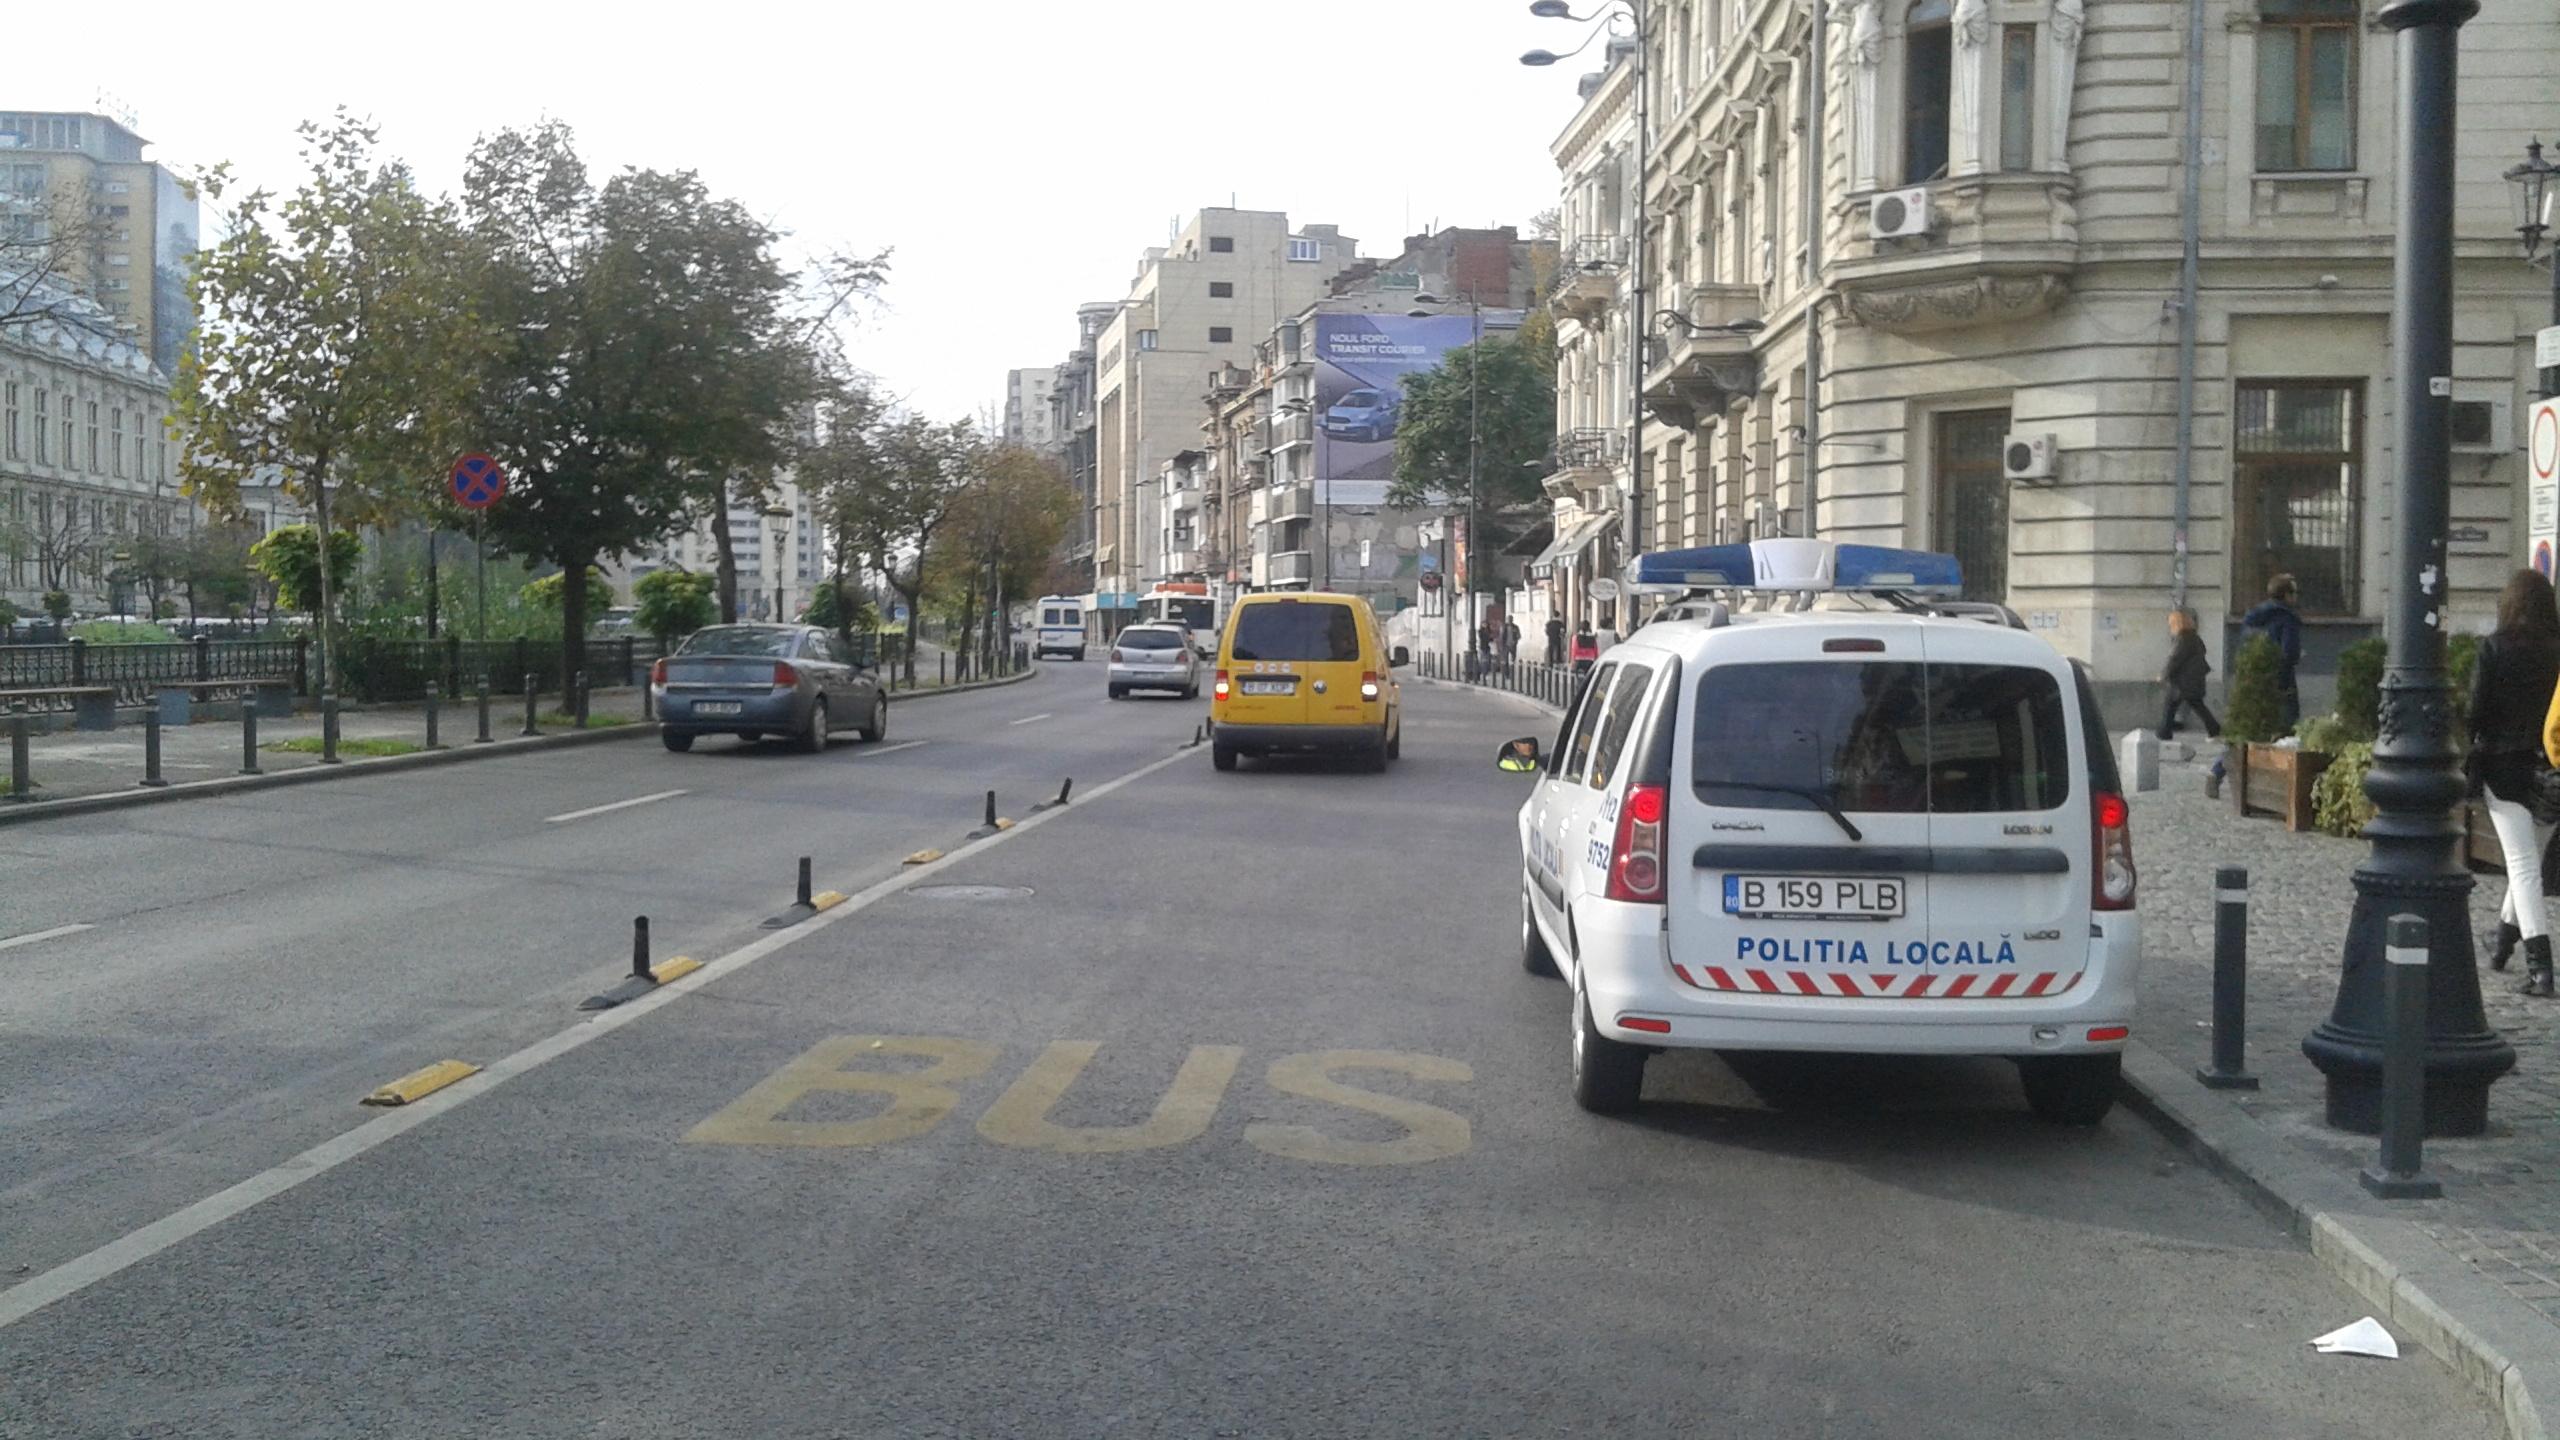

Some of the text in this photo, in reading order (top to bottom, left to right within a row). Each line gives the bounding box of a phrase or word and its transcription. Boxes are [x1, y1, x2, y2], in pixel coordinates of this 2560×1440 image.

[1330, 334, 1390, 343] NOUL FORD
[1330, 344, 1426, 354] TRANSIT COURIER
[1587, 839, 1610, 871] 9752
[1744, 881, 1897, 911] B 159 PLB
[1737, 933, 2016, 965] POLITIA LOCALĂ
[680, 1033, 1474, 1166] BUS
